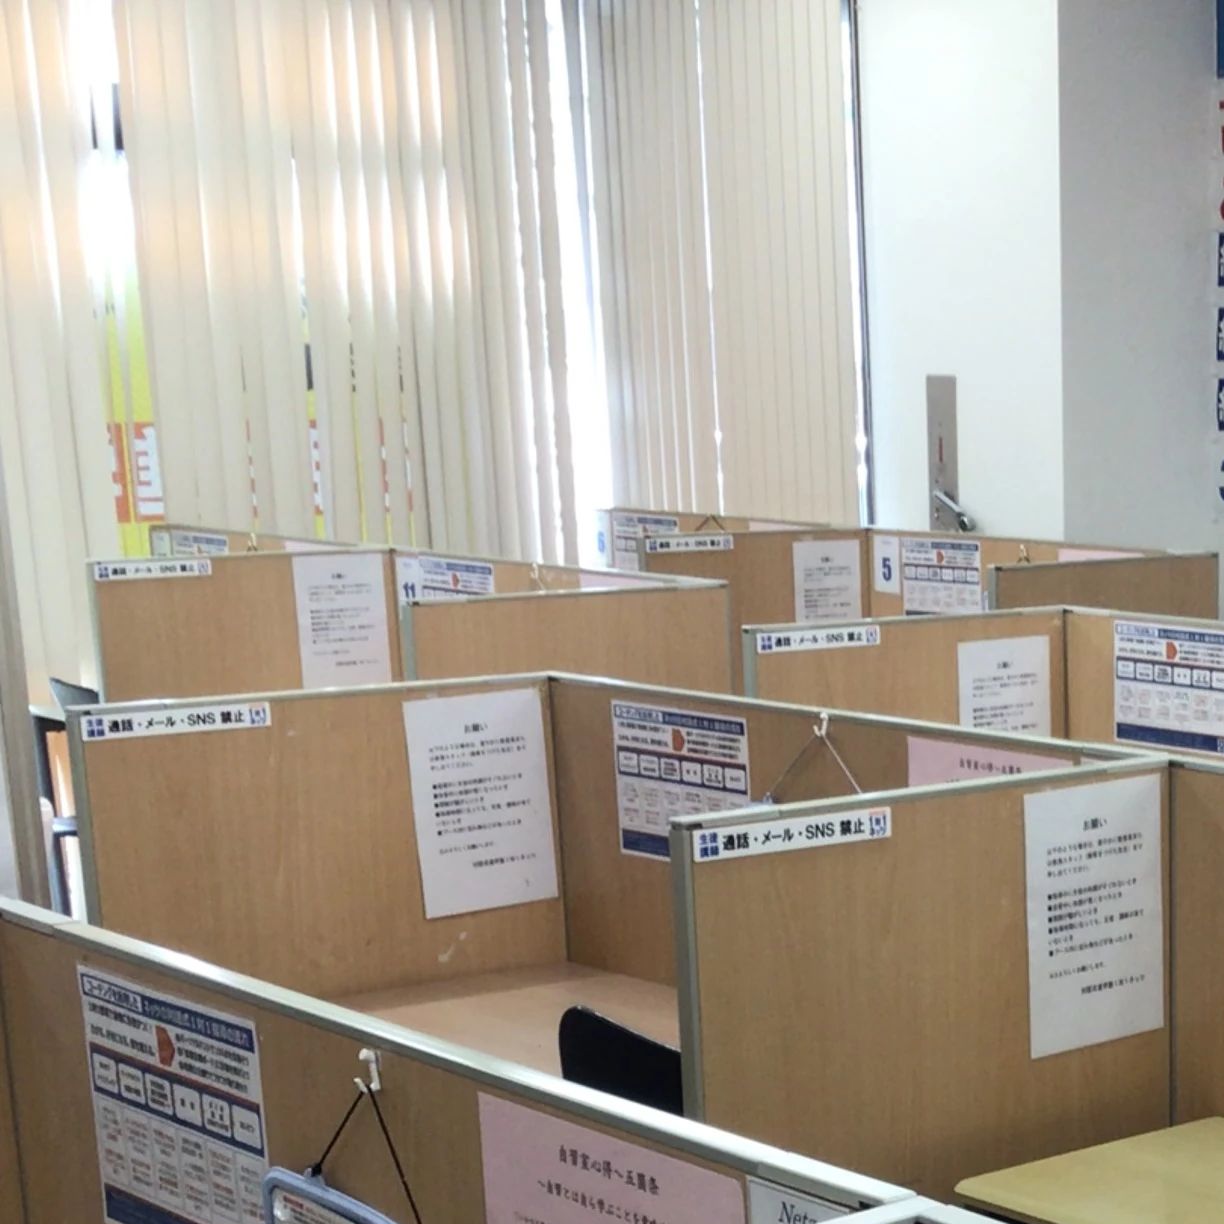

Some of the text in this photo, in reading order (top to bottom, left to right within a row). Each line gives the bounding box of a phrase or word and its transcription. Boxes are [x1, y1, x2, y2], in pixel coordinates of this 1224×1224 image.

[882, 557, 892, 581] 5
[722, 818, 865, 851] 通話・メール・SNS 禁止
